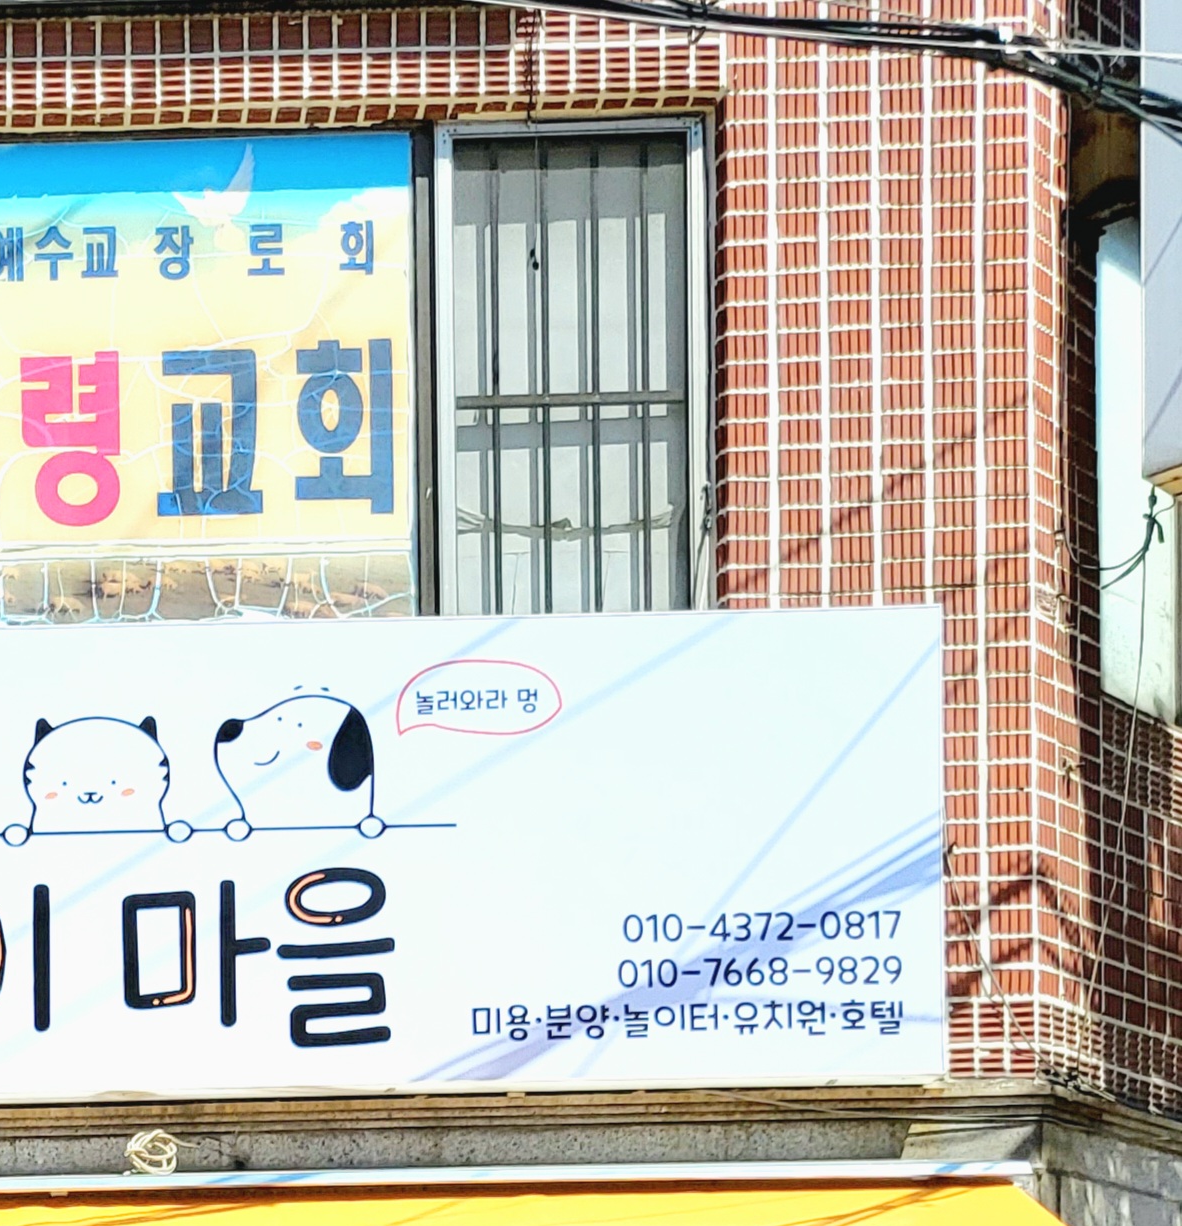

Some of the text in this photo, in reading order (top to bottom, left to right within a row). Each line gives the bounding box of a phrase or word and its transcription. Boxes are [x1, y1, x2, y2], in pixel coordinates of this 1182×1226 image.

[415, 688, 539, 715] 놀러와라 멍
[623, 909, 902, 943] 010-4372-0817
[122, 867, 395, 1048] 마을
[618, 956, 903, 988] 010-7668-9829
